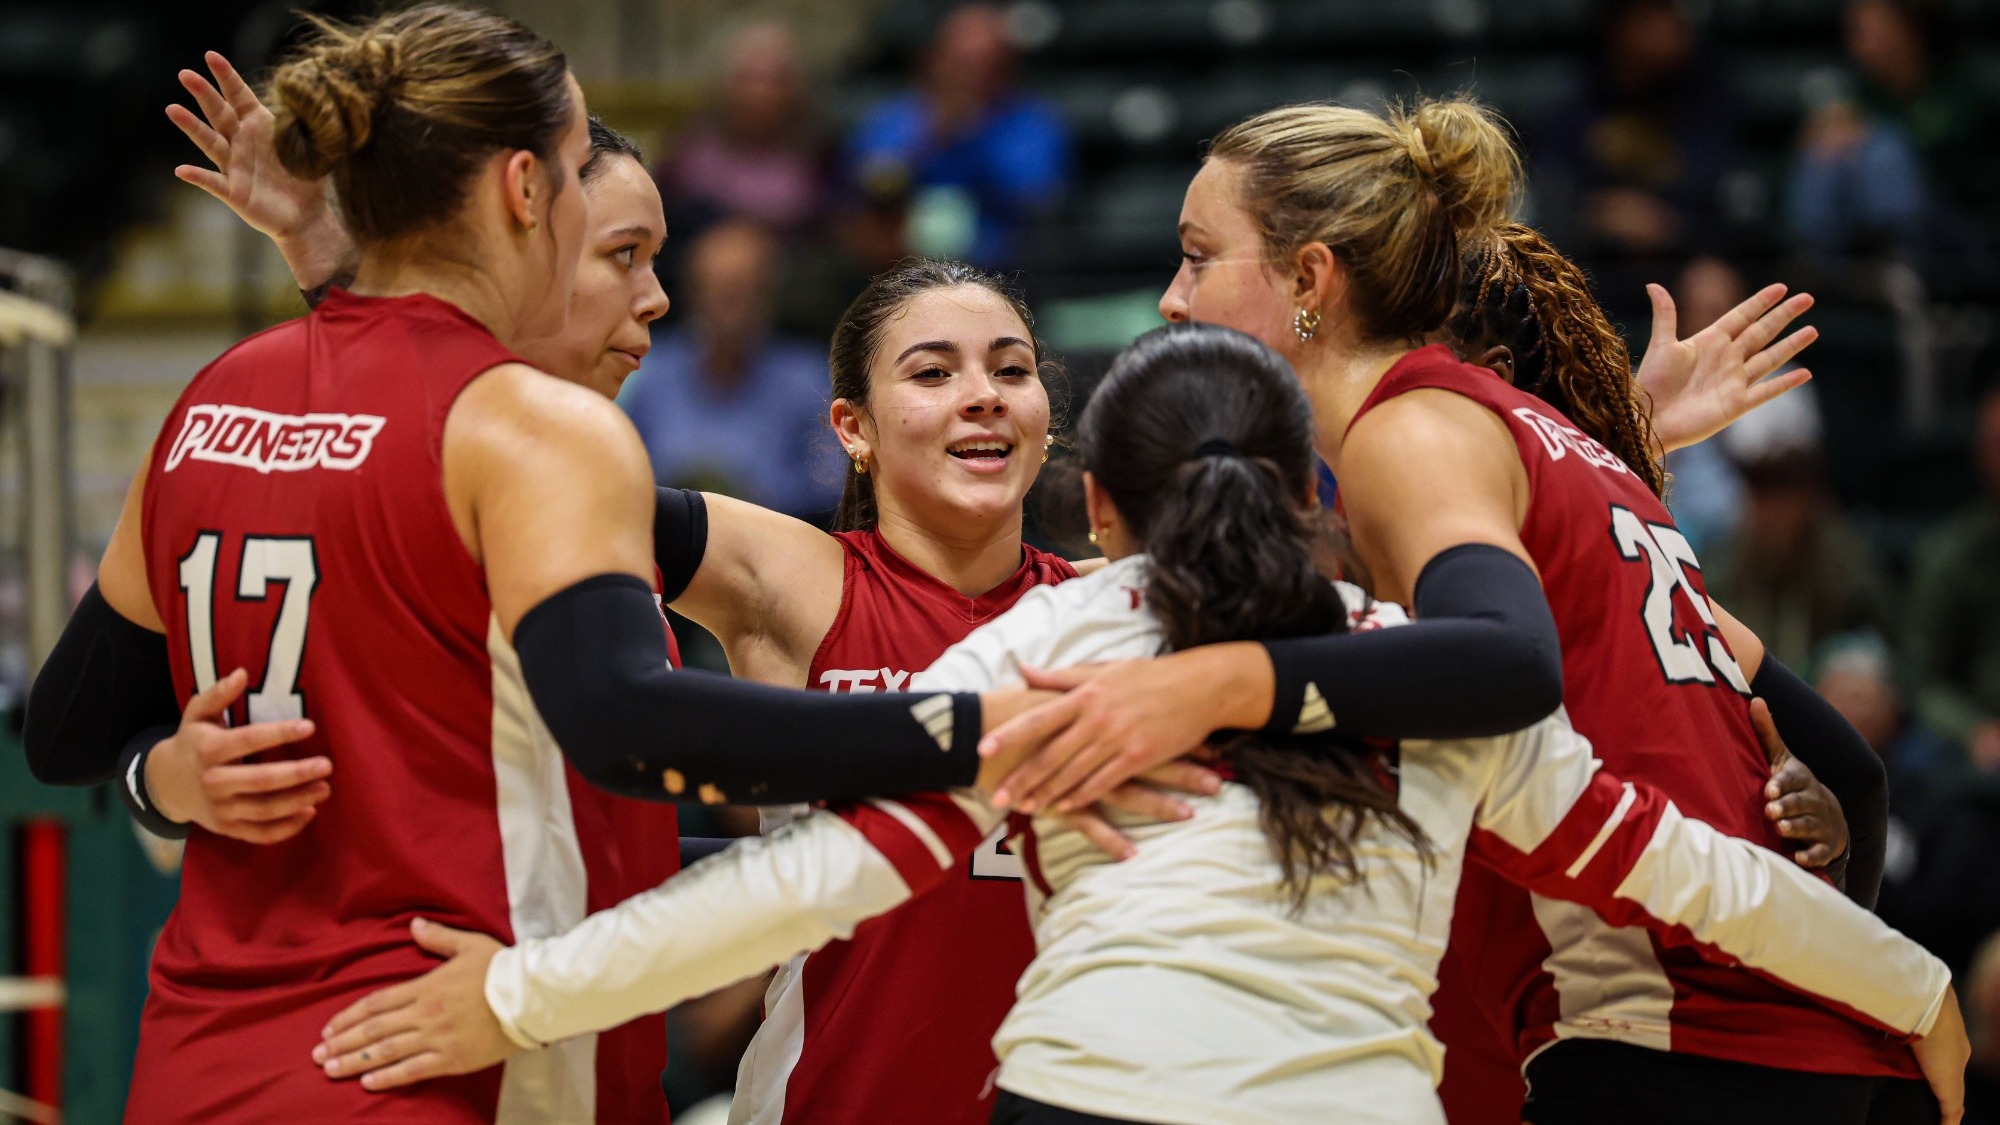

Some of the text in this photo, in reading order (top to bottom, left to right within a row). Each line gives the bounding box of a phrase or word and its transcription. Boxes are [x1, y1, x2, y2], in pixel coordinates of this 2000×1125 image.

[164, 404, 387, 474] PIONEERS
[177, 529, 322, 730] 17
[1608, 502, 1752, 695] 25
